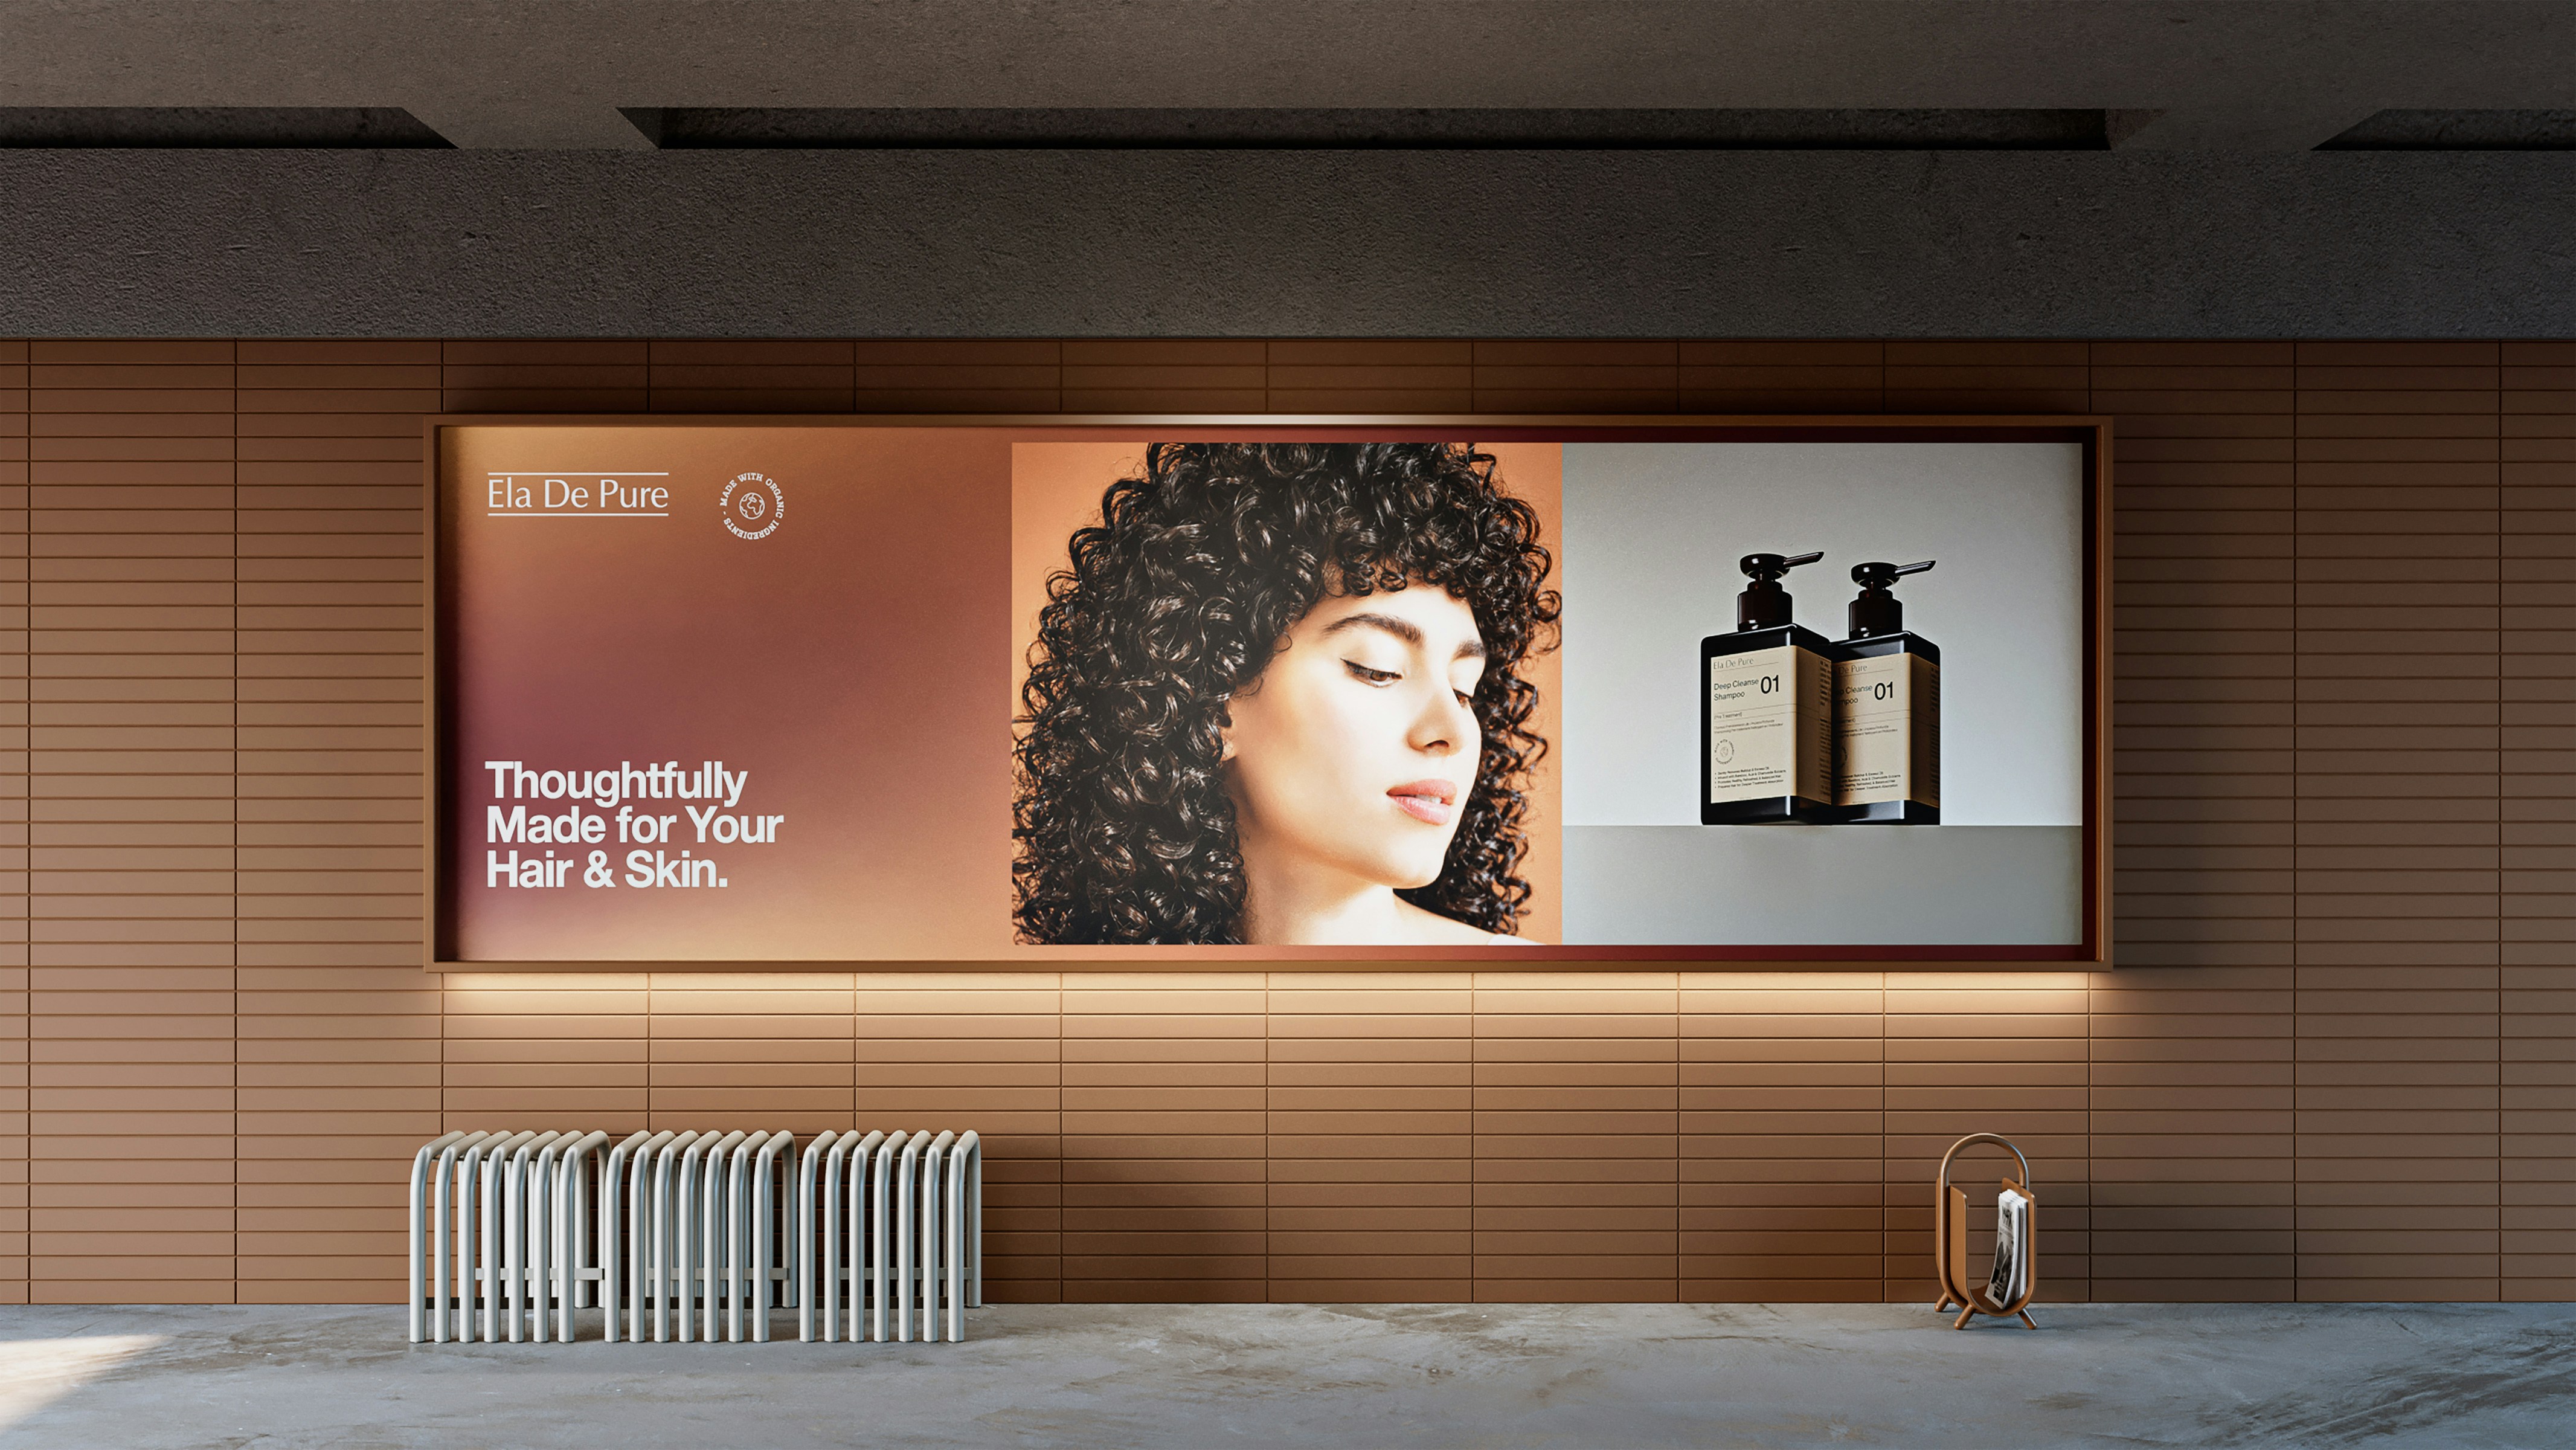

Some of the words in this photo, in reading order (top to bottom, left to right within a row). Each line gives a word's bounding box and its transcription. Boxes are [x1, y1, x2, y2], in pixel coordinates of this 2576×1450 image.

[737, 472, 763, 482] WITH
[489, 477, 532, 508] Ela
[544, 479, 588, 508] De
[600, 479, 669, 508] Pure
[719, 479, 737, 506] MADE
[765, 478, 784, 519] ORGANIC
[723, 518, 780, 540] INGREDIENTS
[1714, 682, 1731, 691] Deep
[1732, 678, 1759, 688] Cleanse
[1761, 675, 1779, 694] 01
[1846, 685, 1873, 694] Cleanse
[1874, 682, 1893, 700] 01
[1714, 691, 1745, 701] Shampoo
[485, 761, 748, 808] Thoughtfully
[487, 805, 606, 843] Made
[615, 805, 676, 843] for
[684, 805, 784, 843] Your
[487, 850, 573, 888] Hair
[583, 849, 616, 888] &
[625, 849, 728, 888] Skin.
